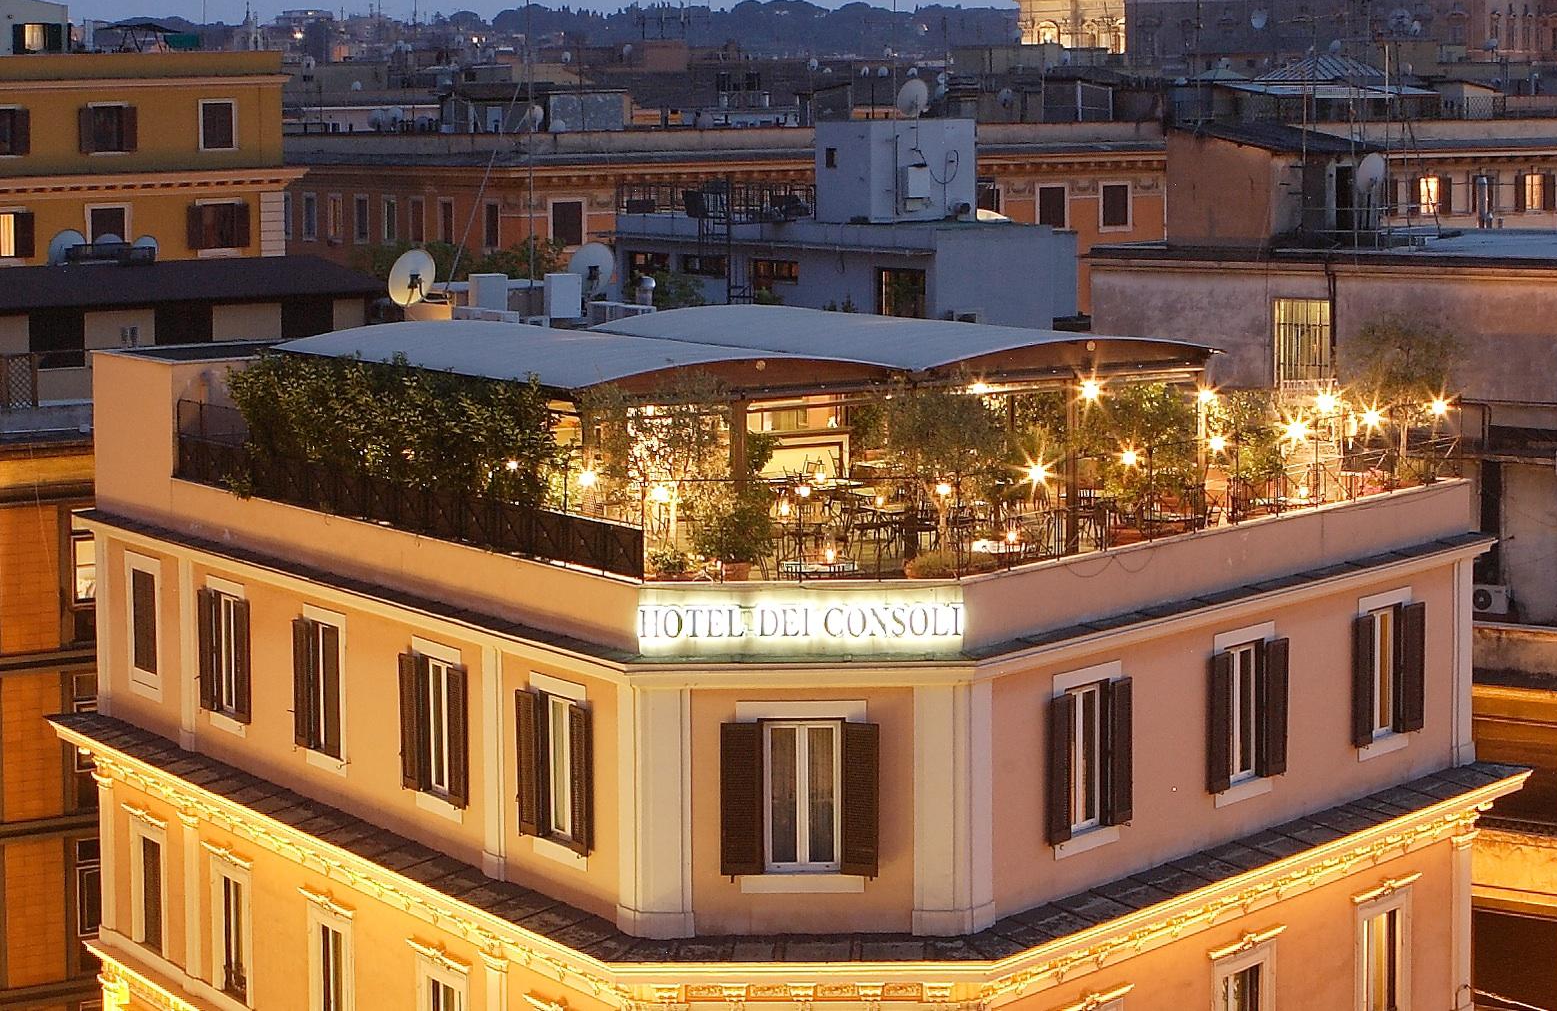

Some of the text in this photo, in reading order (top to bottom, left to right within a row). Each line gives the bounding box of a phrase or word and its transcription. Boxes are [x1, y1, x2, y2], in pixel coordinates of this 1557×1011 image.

[640, 605, 963, 638] HOTEL DEI CONSOLI
